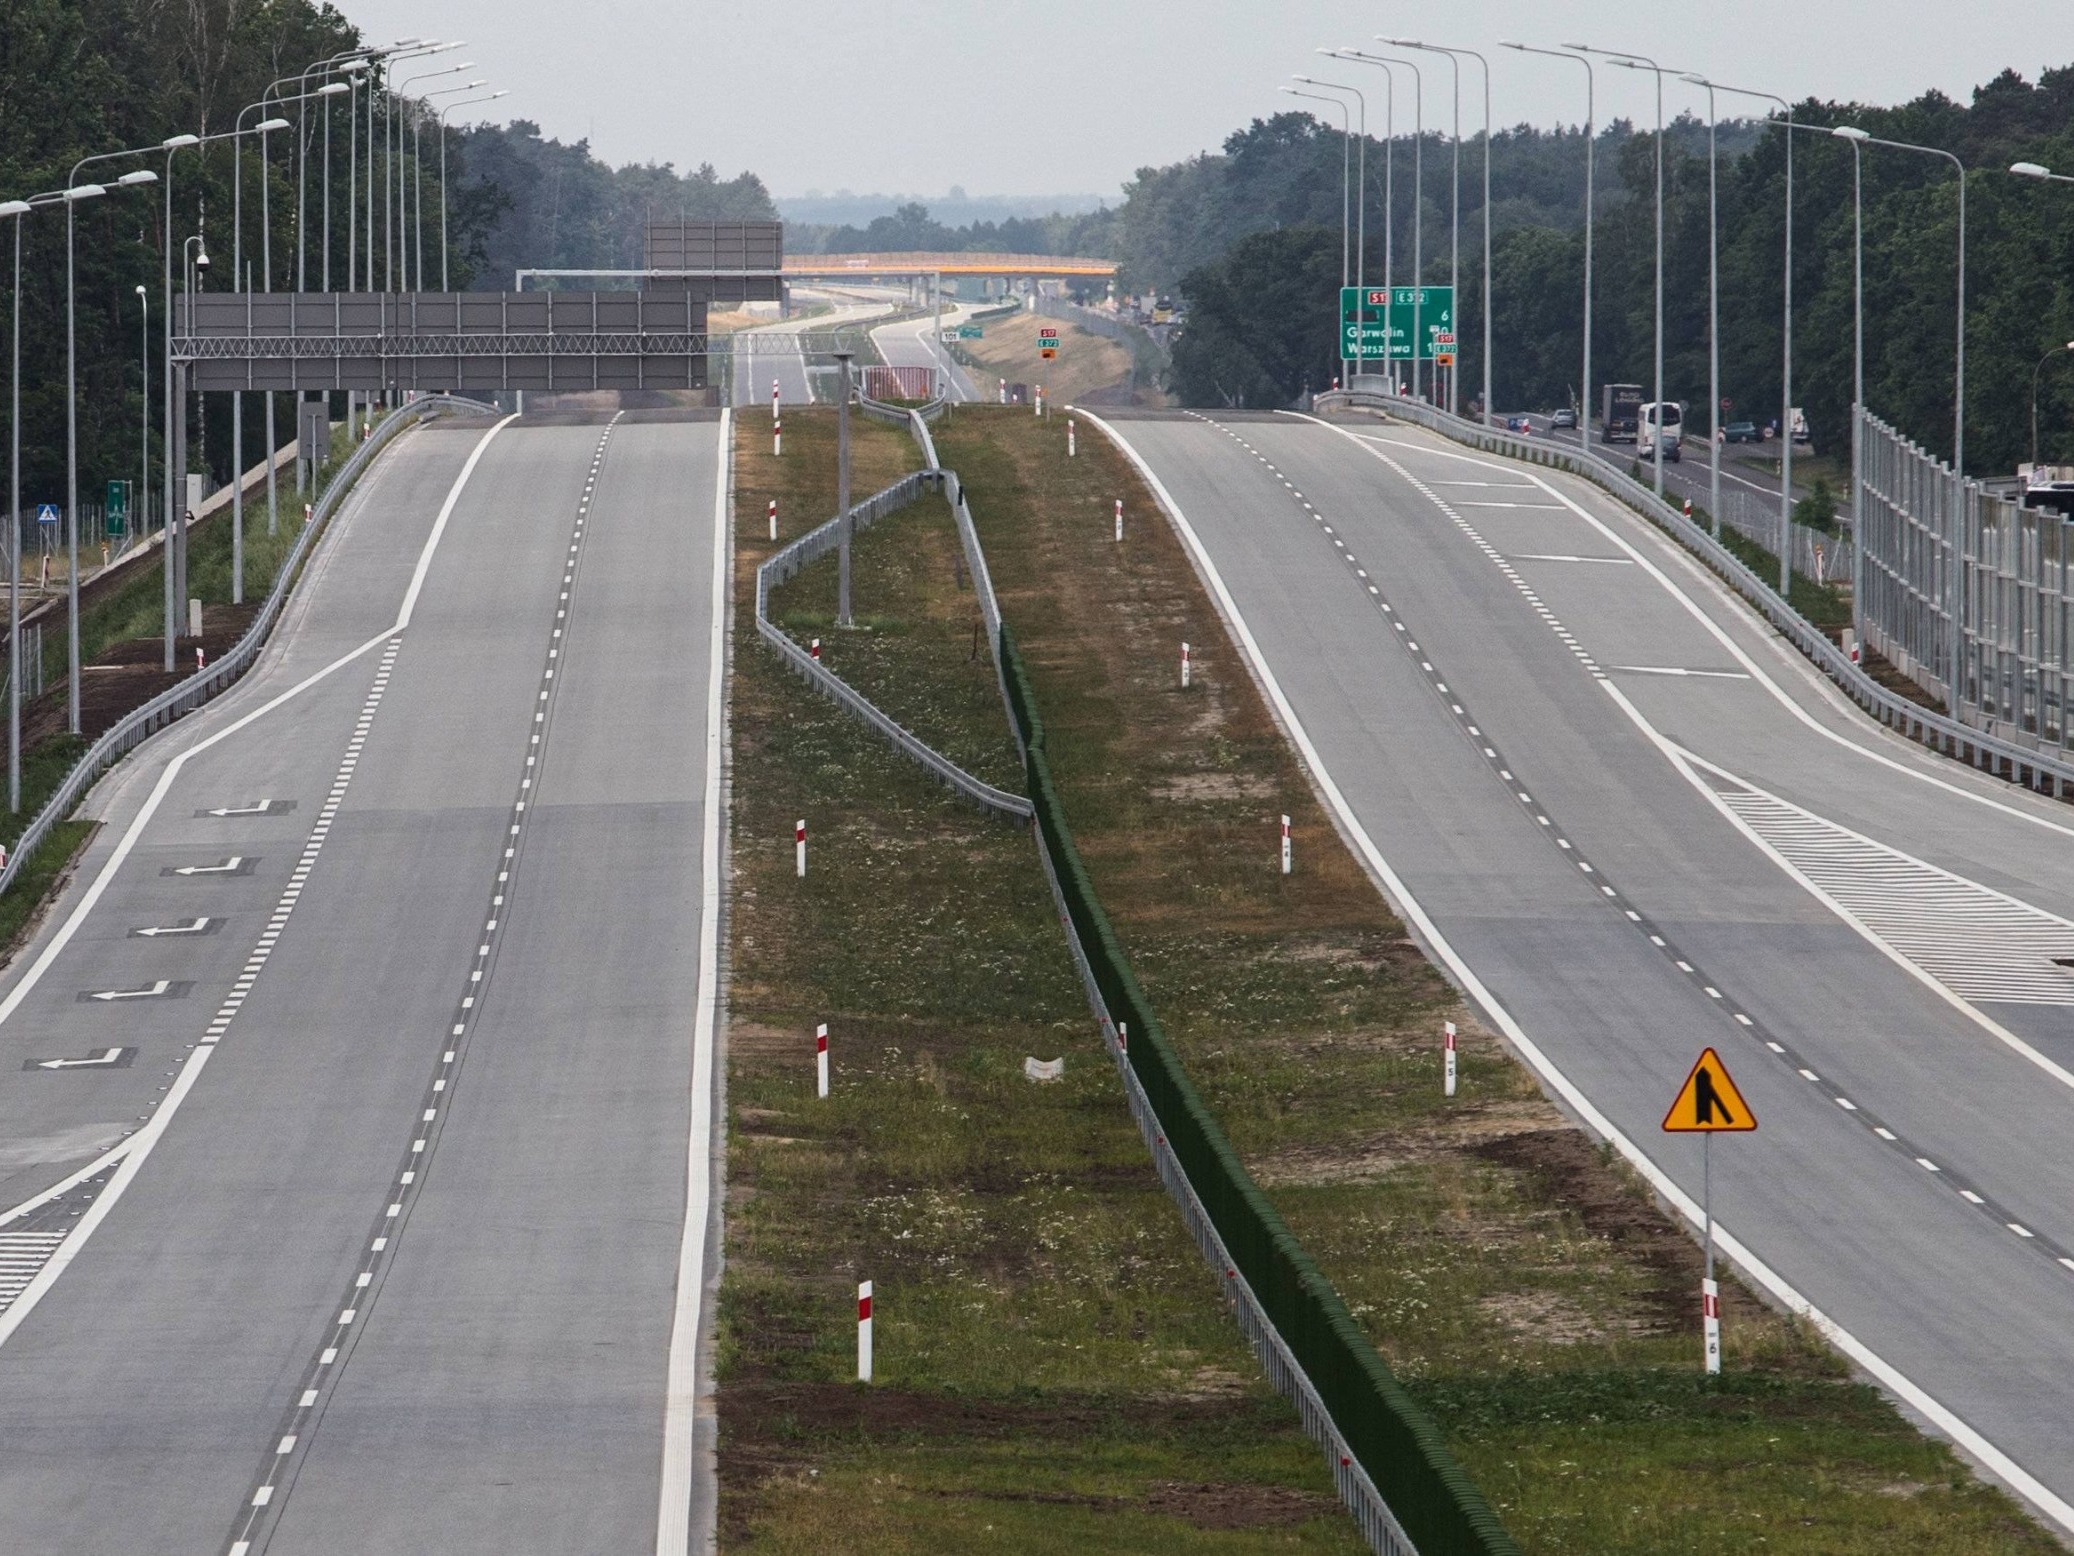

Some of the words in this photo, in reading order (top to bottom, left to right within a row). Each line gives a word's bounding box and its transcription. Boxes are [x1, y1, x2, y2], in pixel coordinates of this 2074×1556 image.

[1399, 293, 1405, 303] E
[1407, 293, 1425, 303] 32
[1441, 310, 1449, 321] 6
[1347, 343, 1410, 354] Warszwa
[1709, 1342, 1717, 1354] 6
